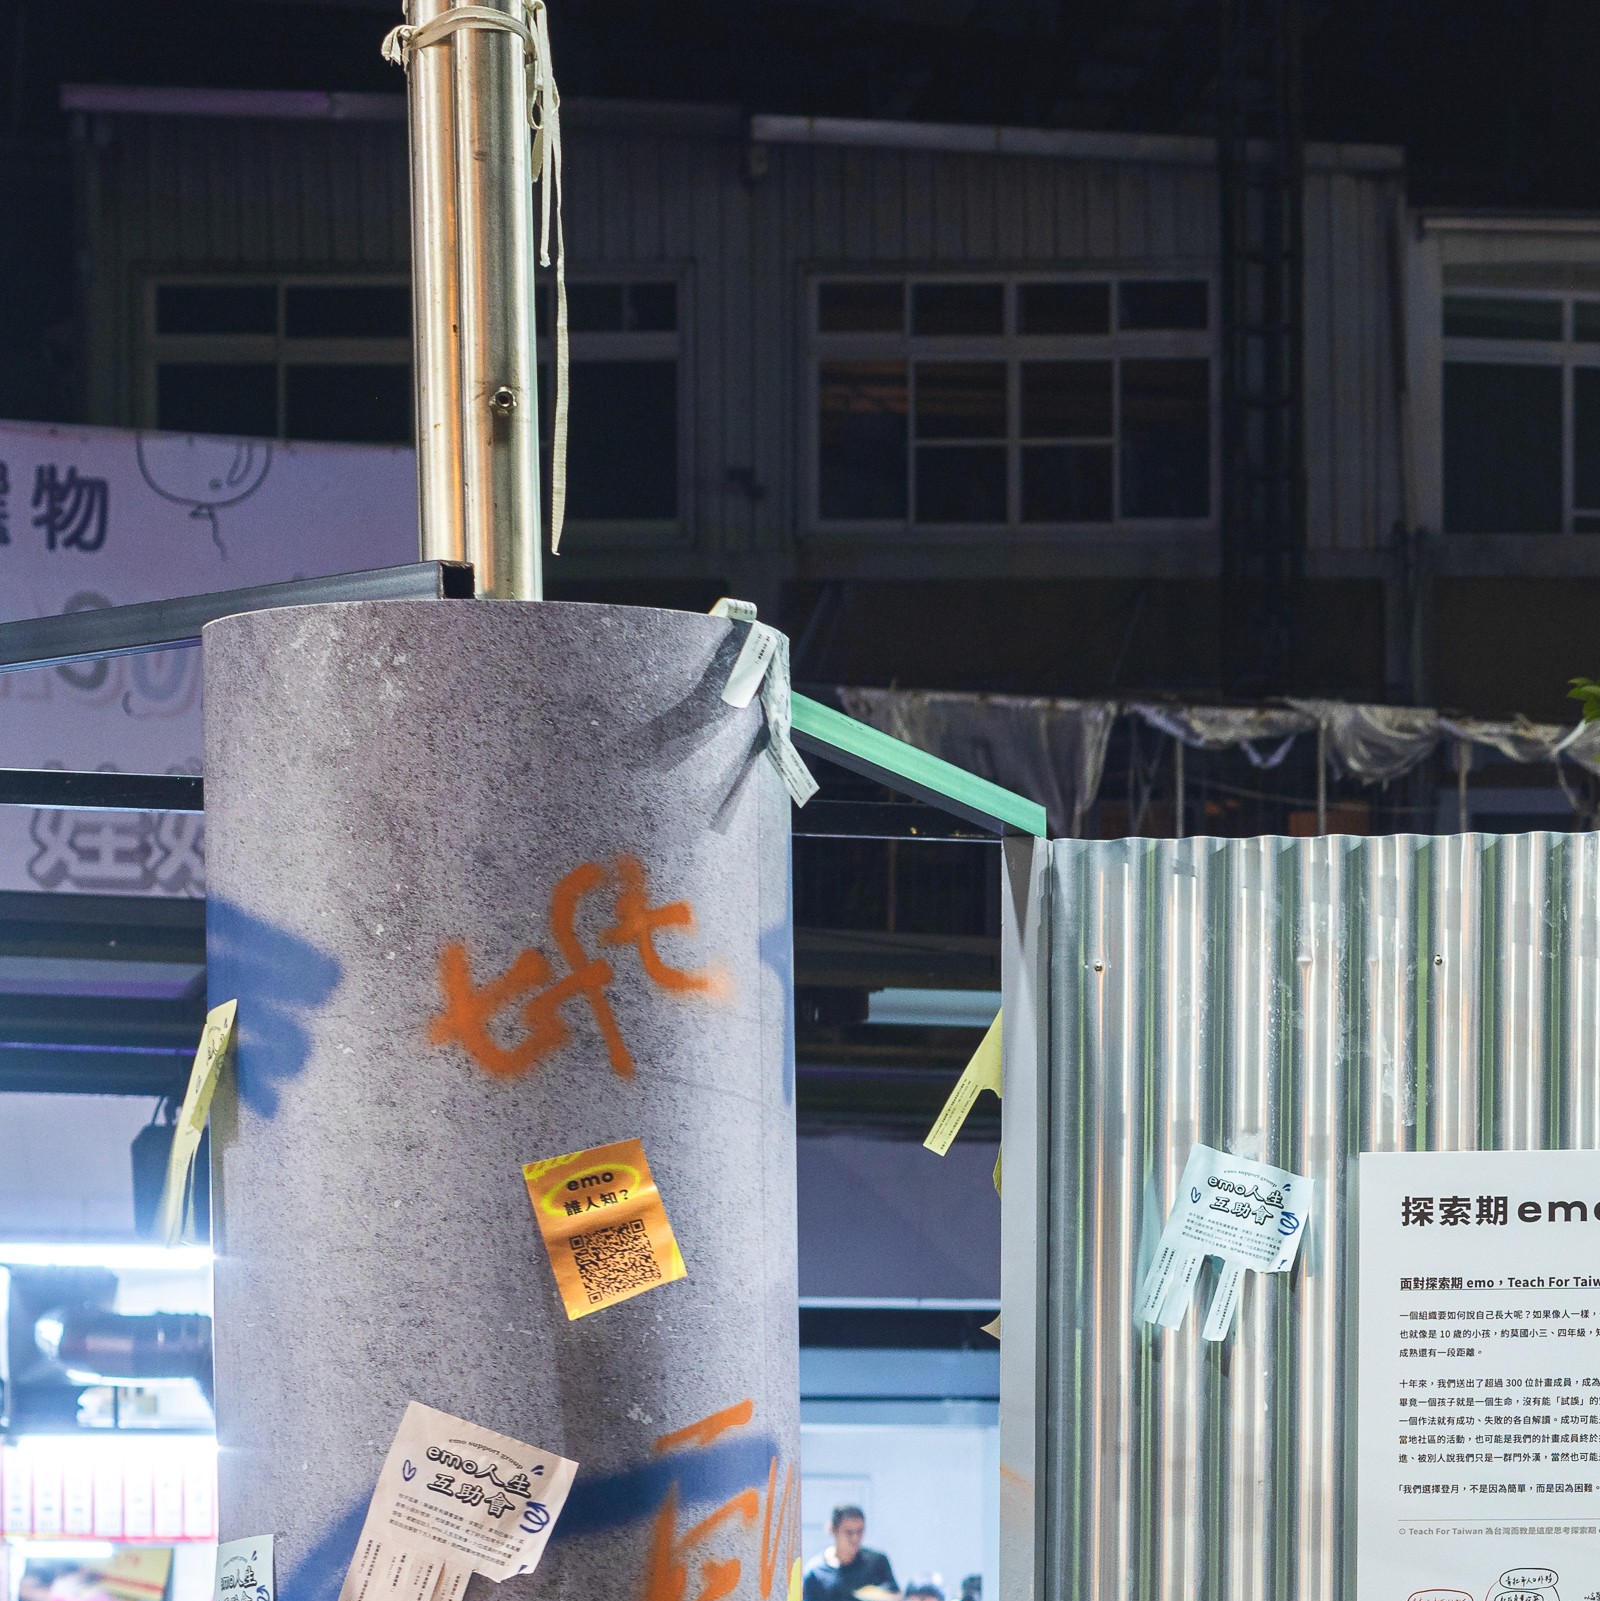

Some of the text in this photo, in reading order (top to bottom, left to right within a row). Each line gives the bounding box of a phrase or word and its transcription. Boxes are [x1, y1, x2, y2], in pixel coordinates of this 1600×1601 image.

[0, 462, 110, 553] 物
[565, 1170, 615, 1193] emo
[1207, 1175, 1284, 1209] emo人生
[561, 1187, 632, 1218] 誰人知？
[1209, 1196, 1274, 1225] 互助會
[1400, 1276, 1463, 1289] 面對探索期
[1548, 1276, 1570, 1289] For
[1399, 1347, 1482, 1358] 成熟還有一段距離。
[1399, 1378, 1504, 1389] 十年來，我們送出了超過
[1505, 1378, 1523, 1388] 300
[426, 1445, 531, 1498] emo人生
[427, 1474, 515, 1519] 互助會
